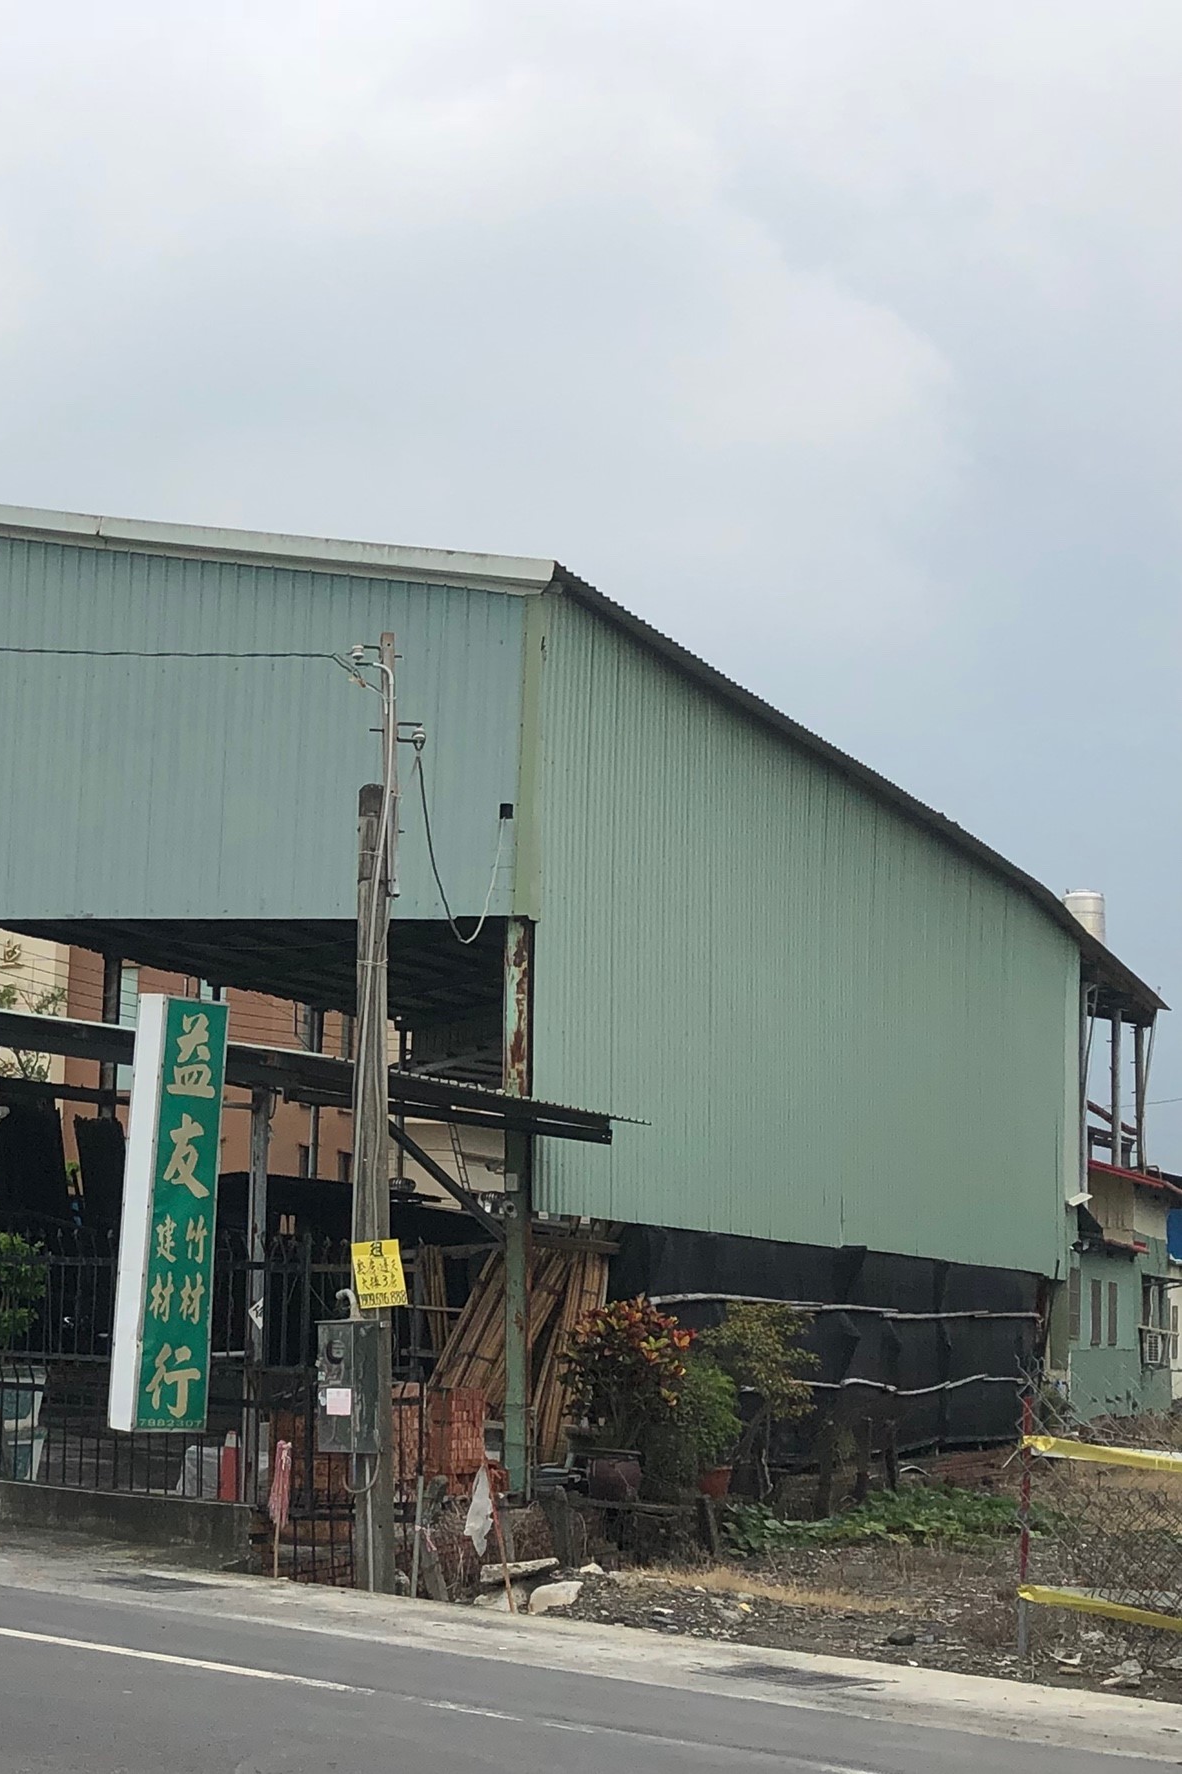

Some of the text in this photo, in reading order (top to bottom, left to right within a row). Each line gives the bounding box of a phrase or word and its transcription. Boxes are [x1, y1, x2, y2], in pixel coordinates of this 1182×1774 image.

[163, 1013, 215, 1199] 益友
[149, 1213, 177, 1323] 建材
[179, 1214, 208, 1325] 竹材
[145, 1342, 201, 1419] 行
